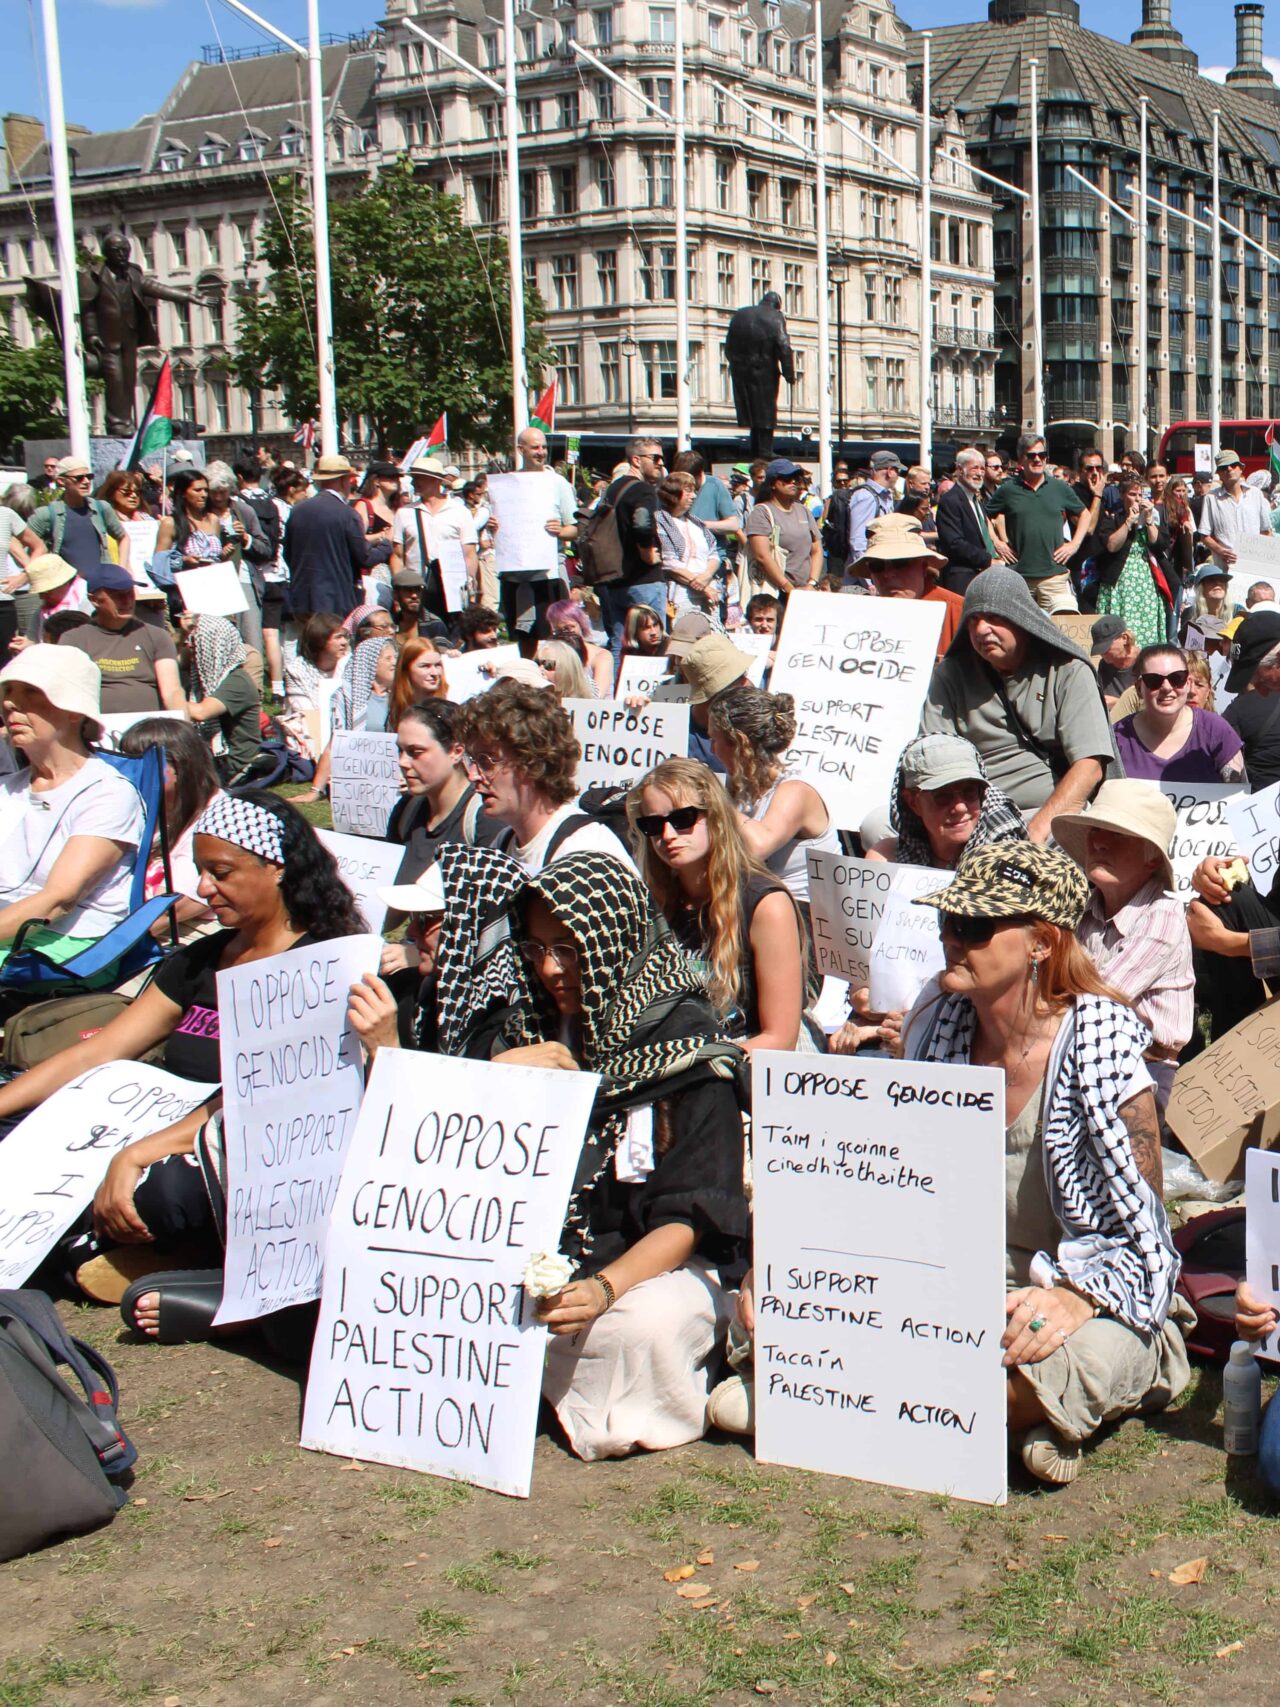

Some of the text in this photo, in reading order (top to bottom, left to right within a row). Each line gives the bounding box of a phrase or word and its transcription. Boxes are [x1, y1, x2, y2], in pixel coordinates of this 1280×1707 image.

[814, 625, 838, 647] I
[787, 653, 916, 682] GENOCIDE
[587, 711, 664, 738] OPPOSE
[800, 699, 884, 722] SUPPORT
[349, 737, 393, 757] OPPOSE
[797, 722, 882, 754] LESTINE
[343, 758, 399, 780] GENOCIDE
[584, 744, 678, 768] ENOCID
[784, 748, 855, 782] CTION
[332, 801, 392, 827] PALESTIN
[809, 859, 891, 891] I OPPO
[816, 917, 832, 940] I
[819, 947, 869, 981] PALEST
[231, 957, 341, 1038] I OPPOSE
[235, 1032, 353, 1106] GENOCIDE
[766, 1067, 994, 1112] I OPPOSE GENOCIDE
[242, 1108, 353, 1172] I SUPPORT
[379, 1104, 559, 1177] I OPPOSE
[33, 1174, 84, 1198] I
[1271, 1168, 1279, 1202] I
[352, 1180, 527, 1247] GENOCIDE
[766, 1264, 879, 1295] I SUPPORT
[1271, 1264, 1279, 1291] I
[340, 1267, 347, 1312] I
[374, 1271, 526, 1326] SUPPORT
[760, 1296, 986, 1348] PALESTINE ACTION
[330, 1320, 519, 1388] PALESTINE
[326, 1378, 496, 1454] ACTION
[769, 1374, 977, 1434] PALESTINE ACTION
